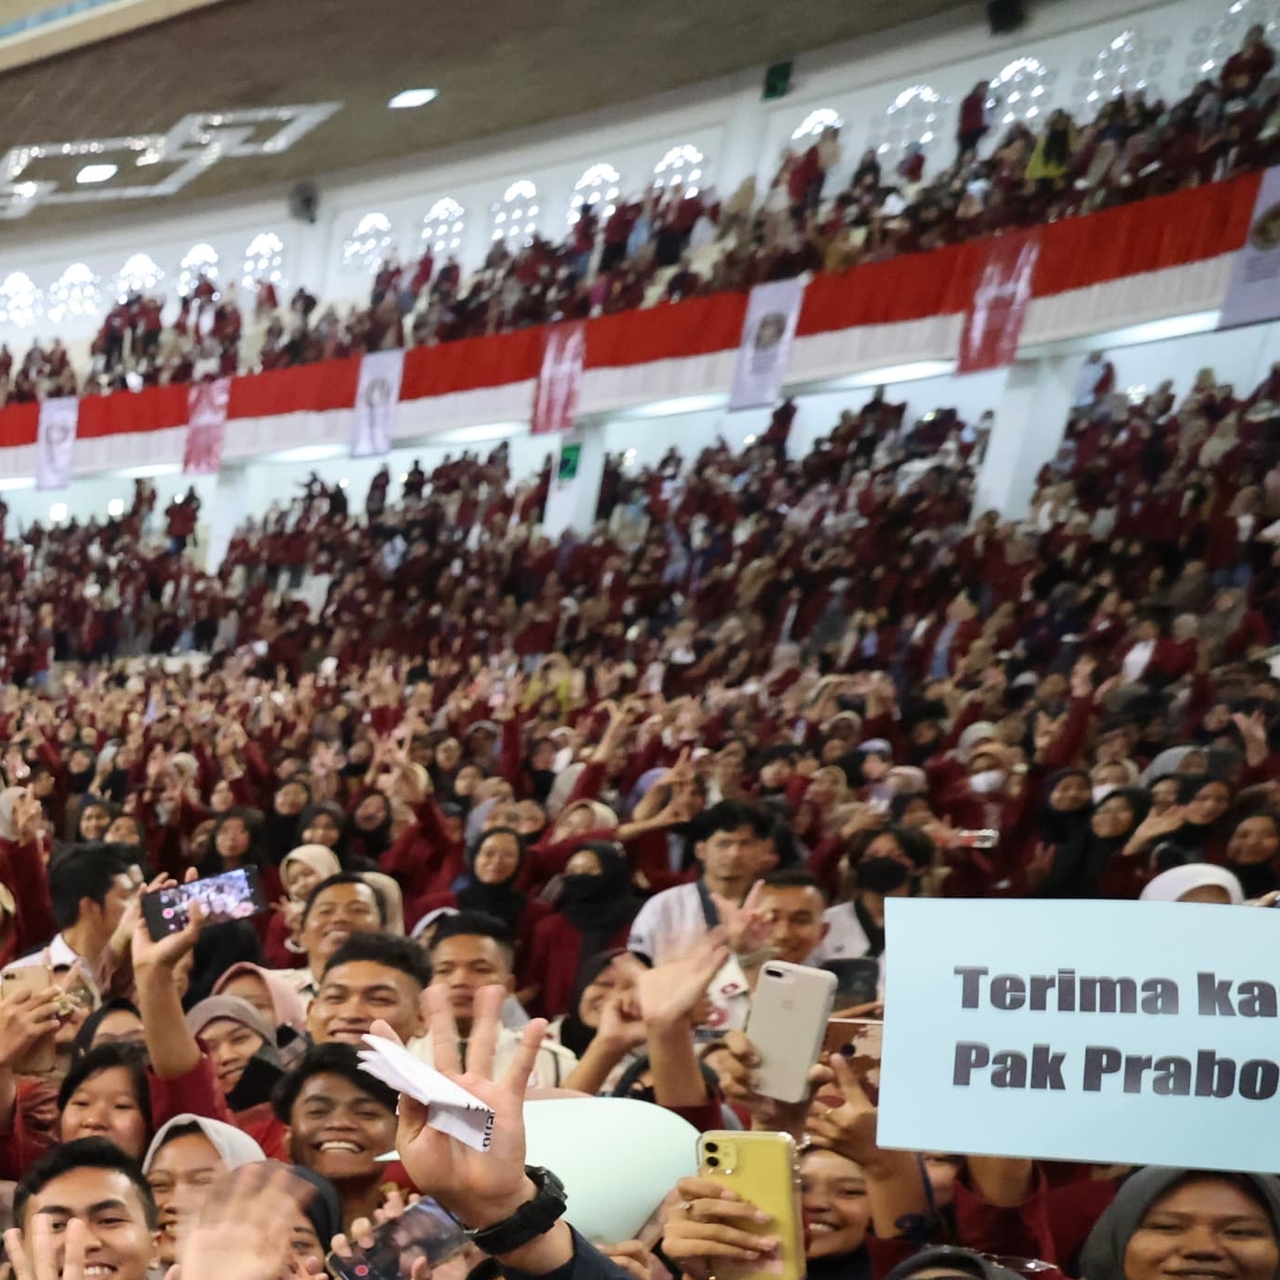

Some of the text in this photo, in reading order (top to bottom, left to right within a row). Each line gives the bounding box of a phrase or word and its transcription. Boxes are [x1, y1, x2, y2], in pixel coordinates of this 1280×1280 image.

[953, 965, 1180, 1016] Terima
[952, 1040, 1280, 1101] Pak Prabo
